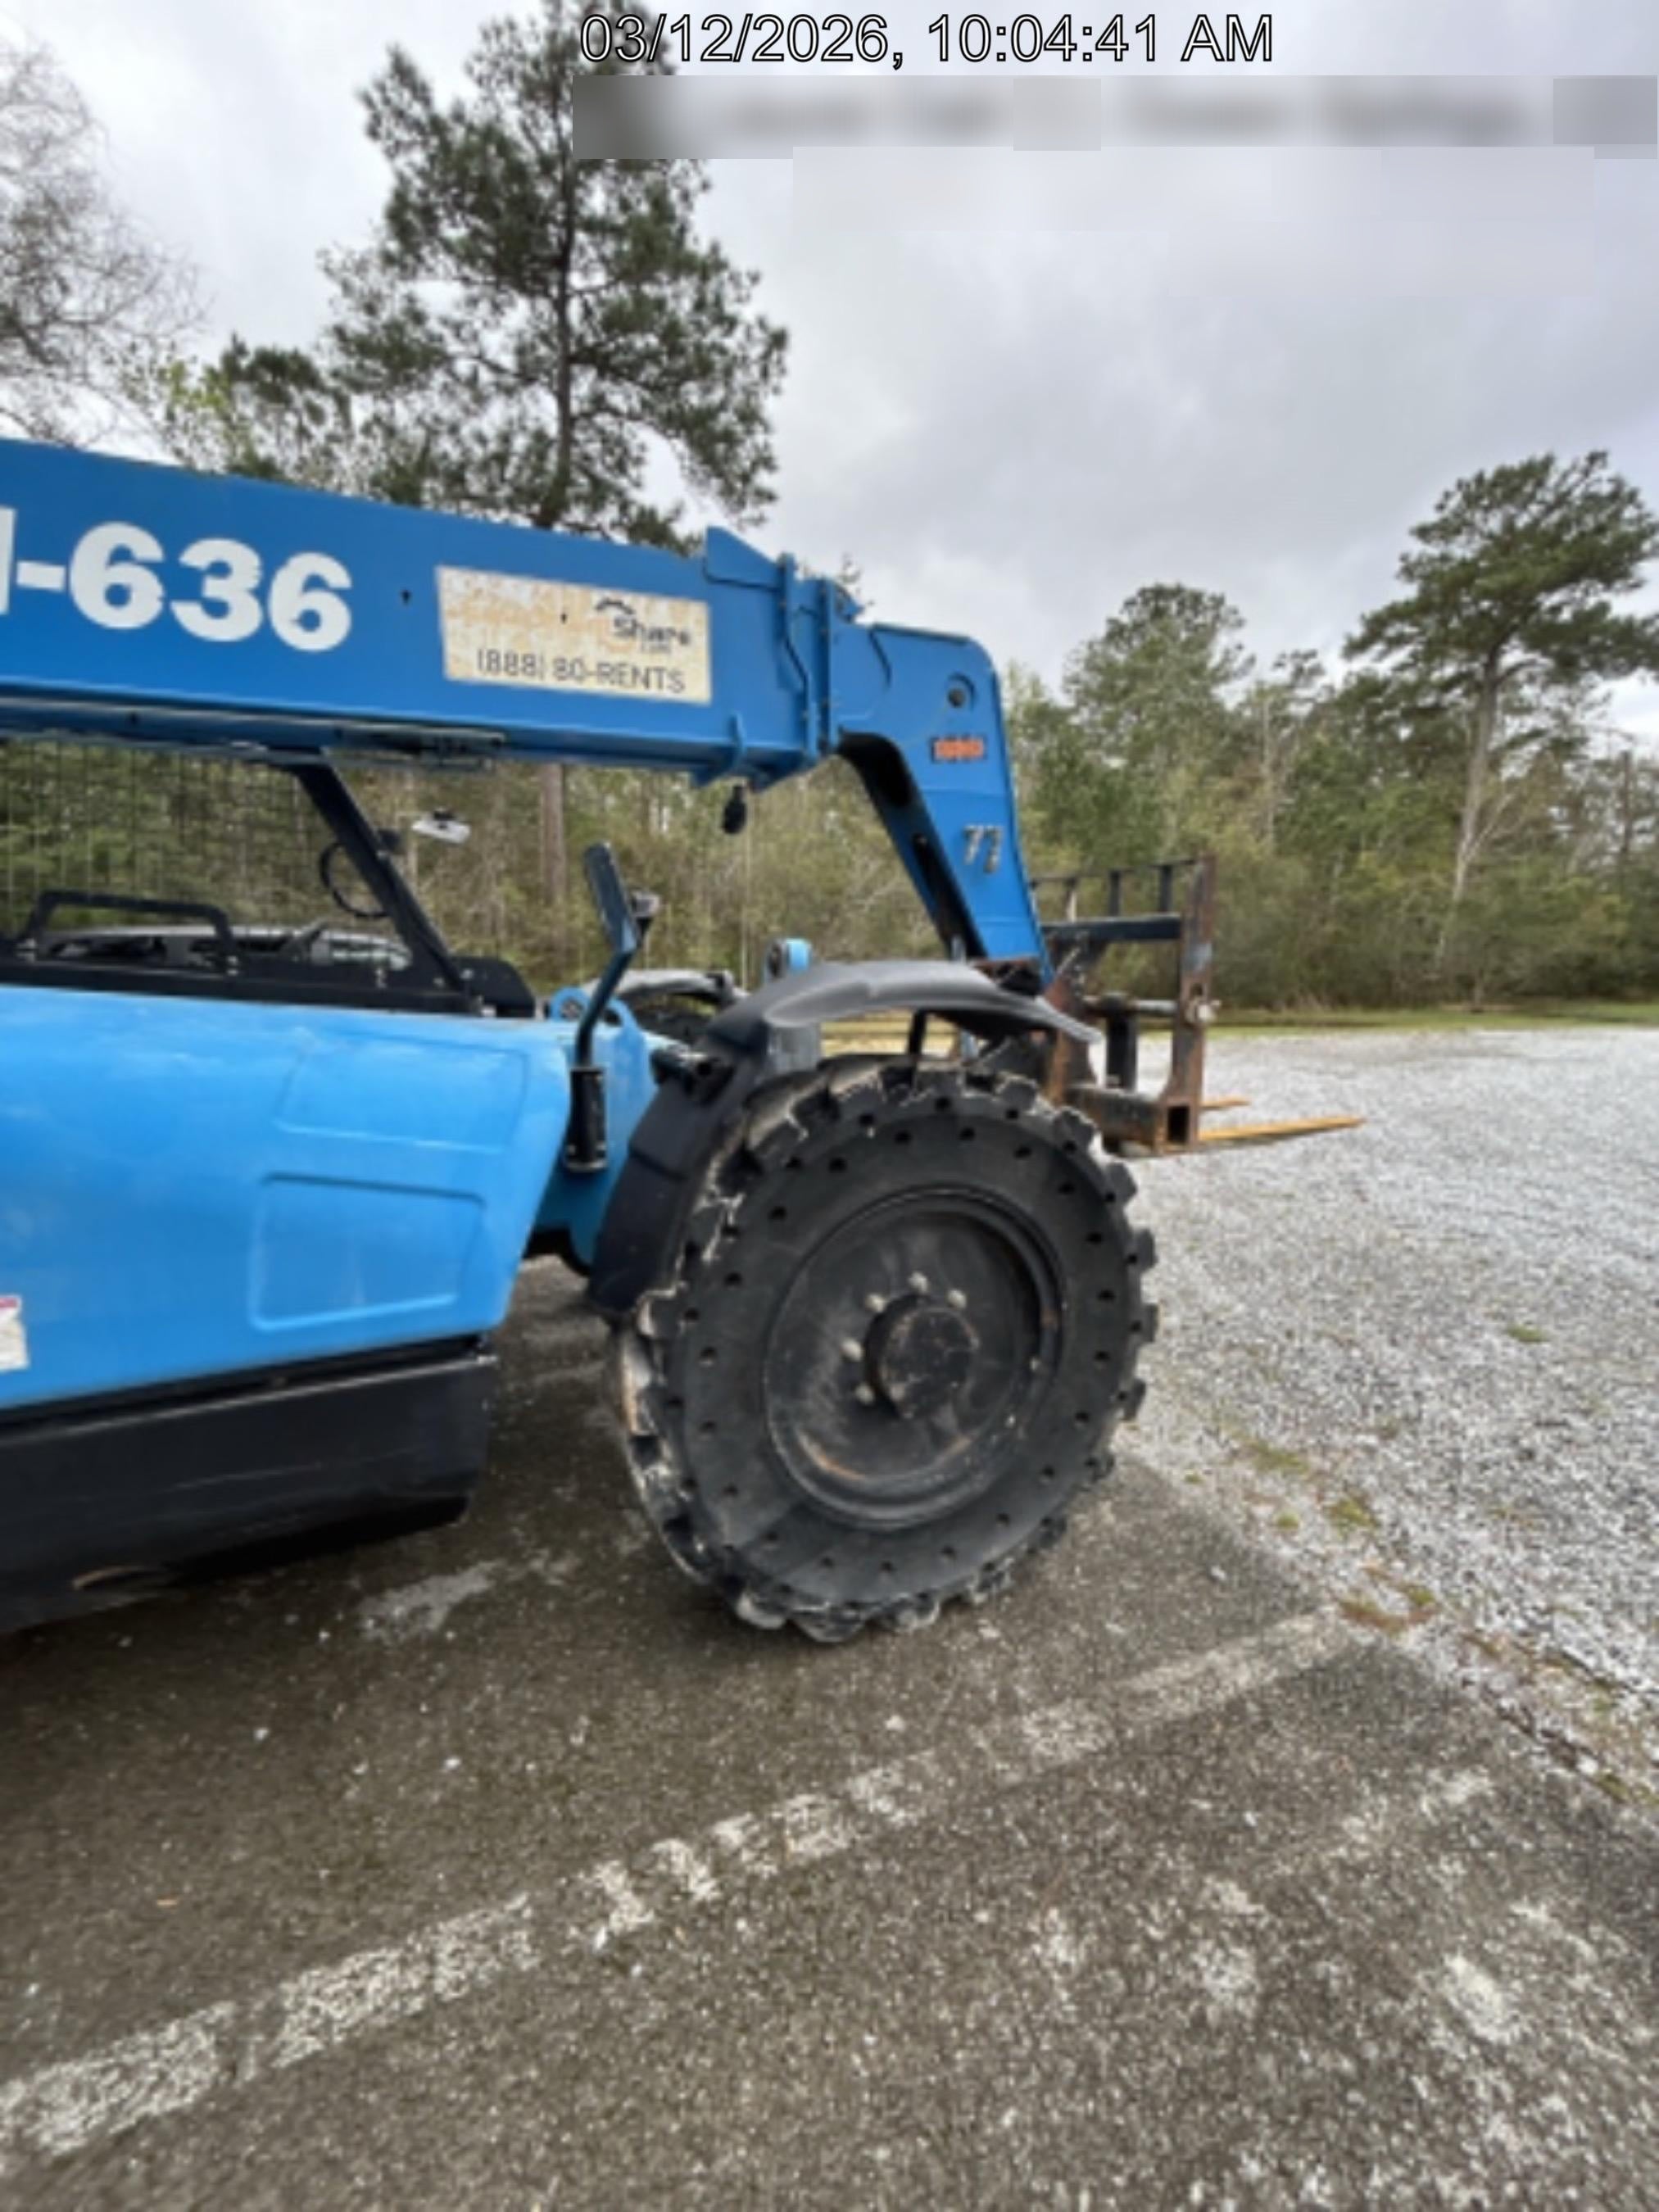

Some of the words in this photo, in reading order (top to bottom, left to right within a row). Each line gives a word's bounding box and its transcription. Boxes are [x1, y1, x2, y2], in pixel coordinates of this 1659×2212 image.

[0, 505, 352, 651] -636
[476, 648, 545, 678] (888)
[551, 655, 687, 693] 80-RENTS
